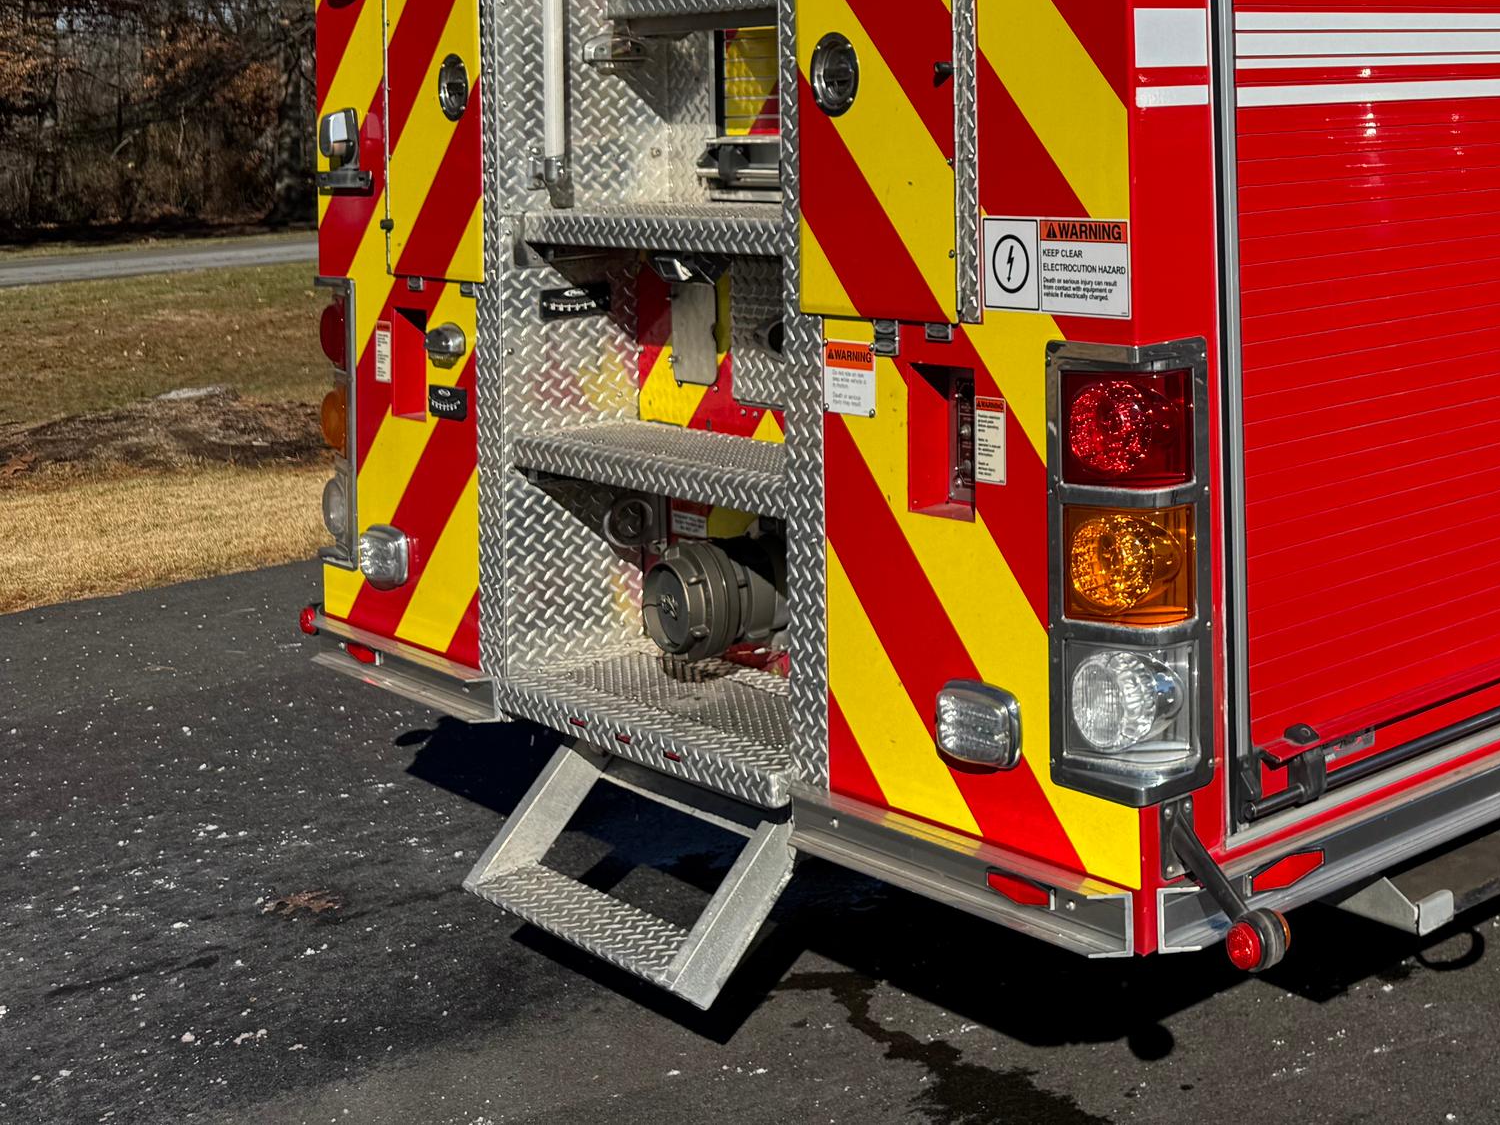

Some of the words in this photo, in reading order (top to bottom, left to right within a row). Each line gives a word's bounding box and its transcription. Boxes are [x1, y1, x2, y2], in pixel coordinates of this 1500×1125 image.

[1058, 223, 1122, 240] WARNING
[1043, 248, 1059, 257] KEEP
[1061, 249, 1083, 258] CLEAR
[1043, 262, 1097, 273] ELECTROCUTION
[1098, 265, 1126, 275] HAZARD
[834, 349, 872, 363] WARNING
